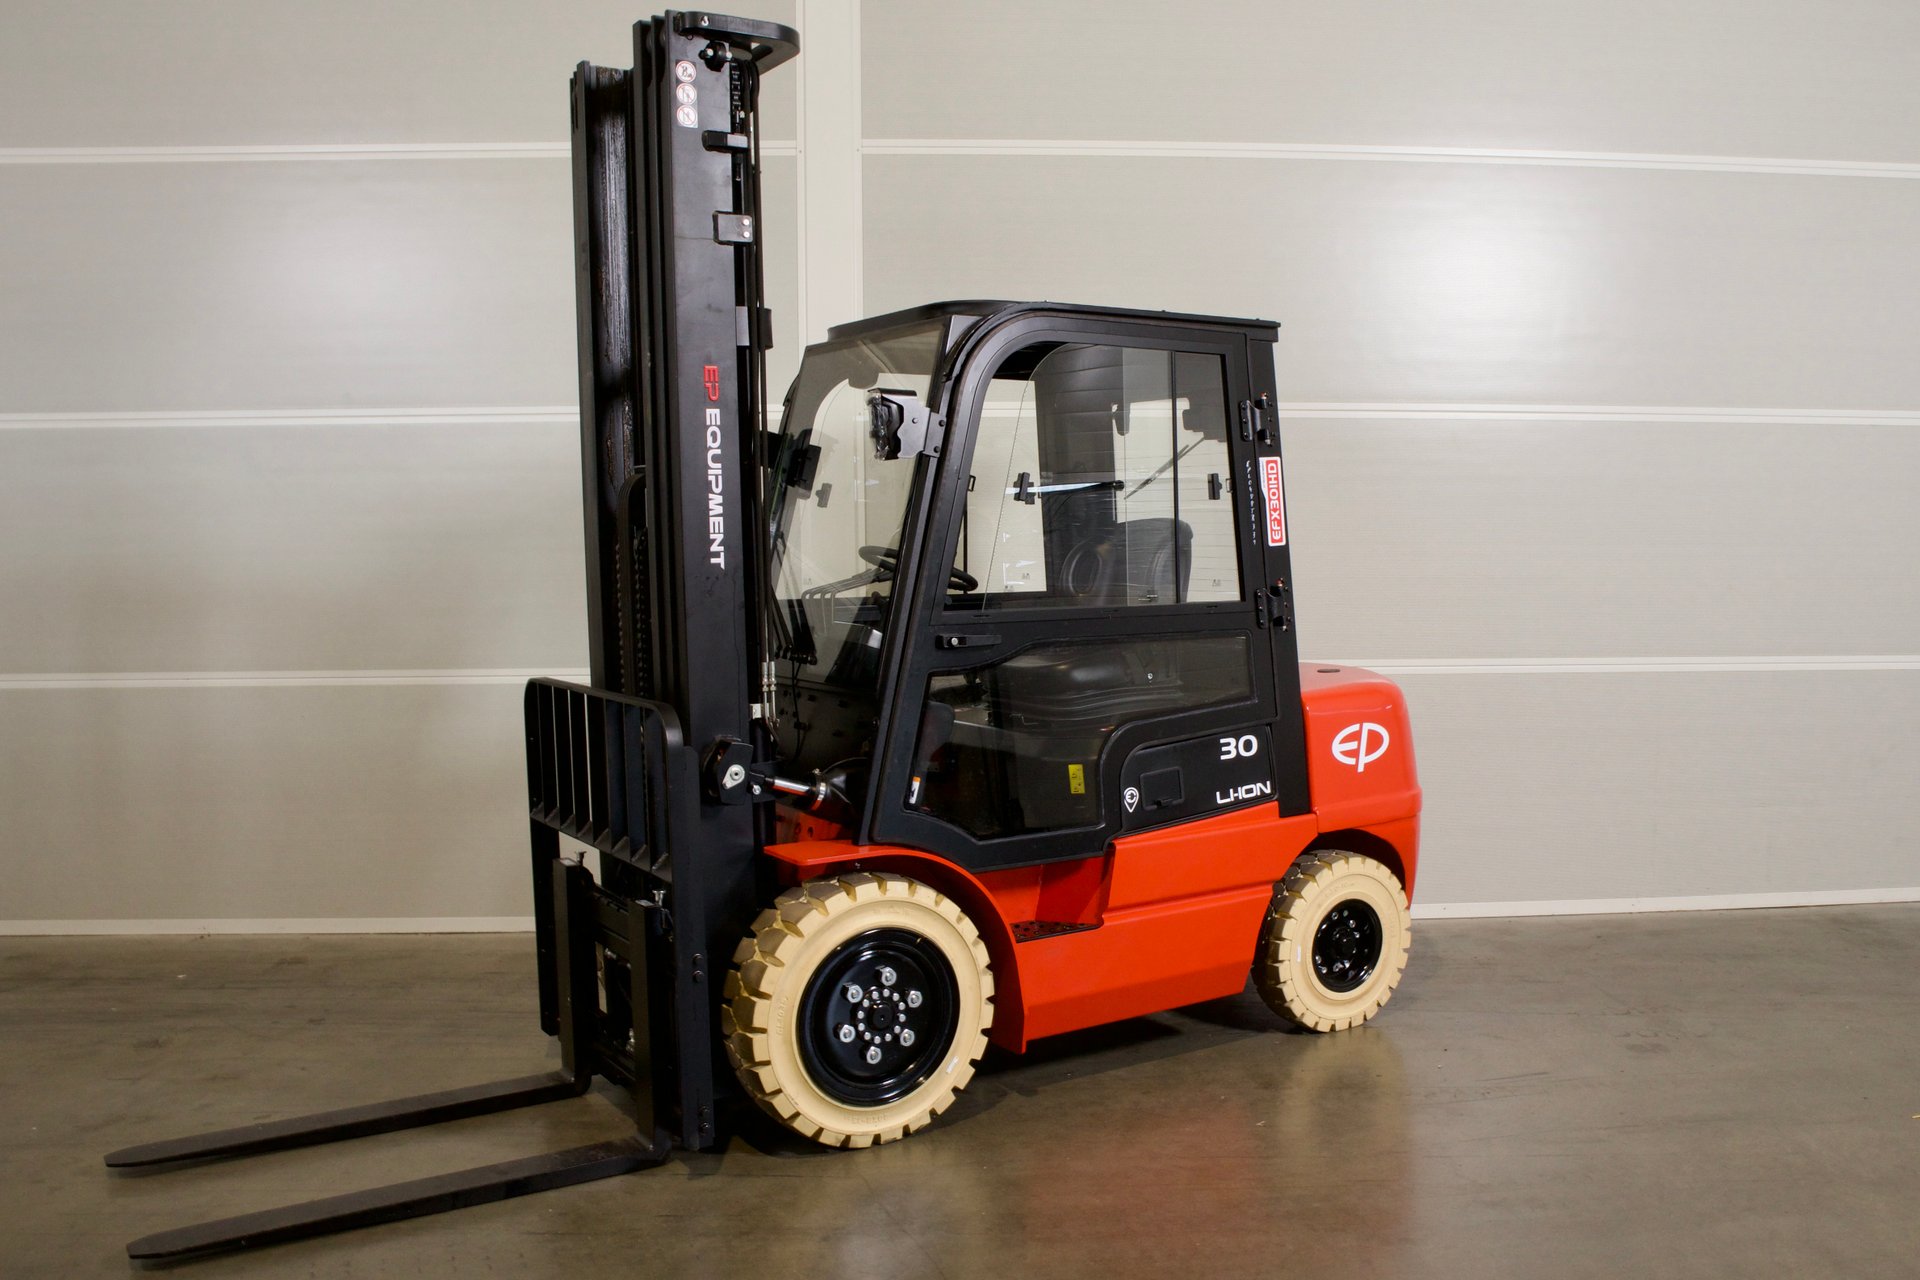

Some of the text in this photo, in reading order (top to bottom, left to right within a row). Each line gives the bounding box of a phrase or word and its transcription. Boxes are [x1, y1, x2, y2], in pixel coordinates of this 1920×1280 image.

[703, 364, 726, 570] EP EQUIPMENT
[1219, 734, 1258, 761] 30
[1331, 722, 1390, 773] EP
